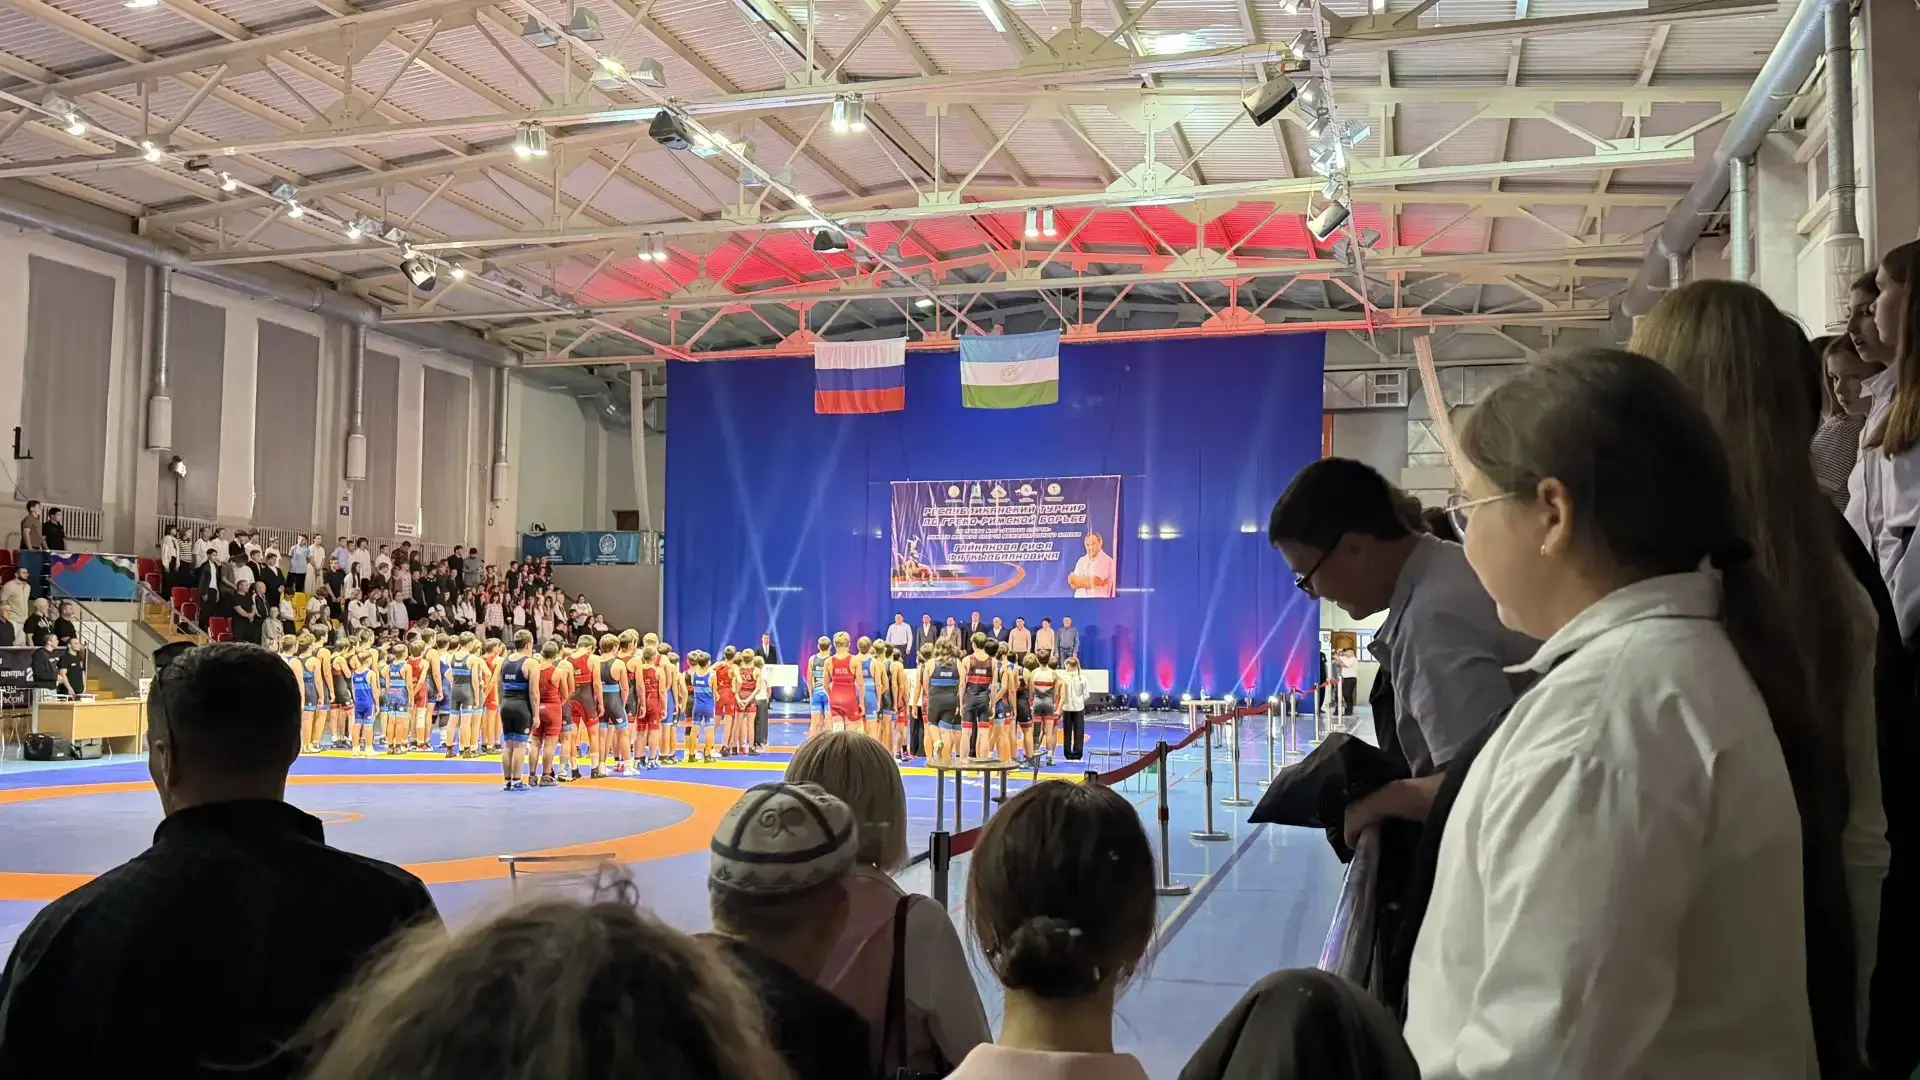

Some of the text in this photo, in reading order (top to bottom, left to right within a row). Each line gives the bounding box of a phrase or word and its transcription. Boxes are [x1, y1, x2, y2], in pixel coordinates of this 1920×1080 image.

[1040, 504, 1086, 513] ТУРНИР
[923, 517, 938, 526] ПО
[1039, 514, 1086, 524] БОРЬБЕ
[1020, 542, 1053, 551] РИФА
